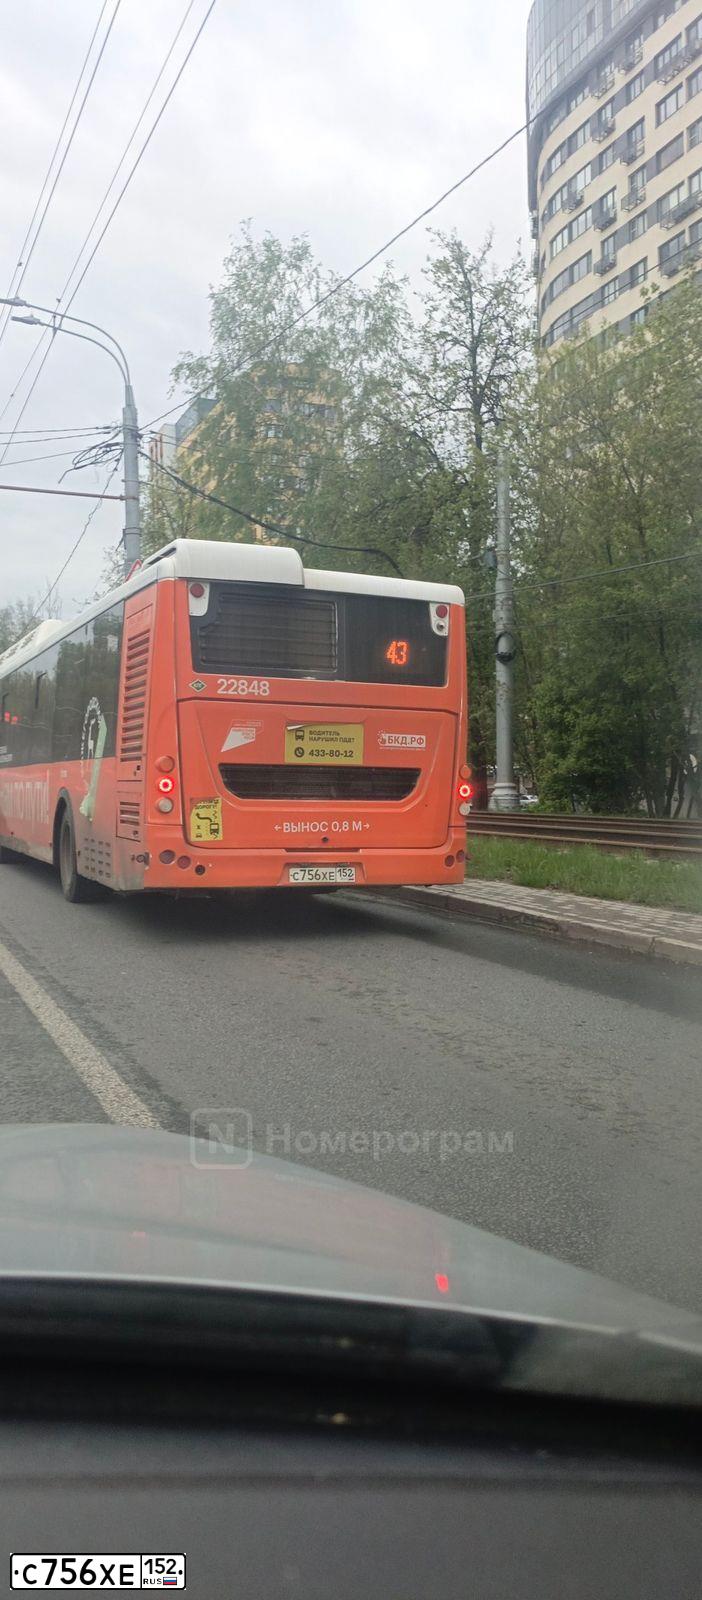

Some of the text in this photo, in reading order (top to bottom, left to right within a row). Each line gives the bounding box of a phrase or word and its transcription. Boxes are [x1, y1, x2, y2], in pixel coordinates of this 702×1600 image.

[386, 640, 409, 665] 43
[217, 678, 269, 696] 22848
[387, 735, 425, 746] БКД.РФ
[309, 749, 354, 758] 433-80-12
[283, 821, 362, 833] ВЫНОС 0,8 М
[292, 868, 354, 881] С756ХЕ 152
